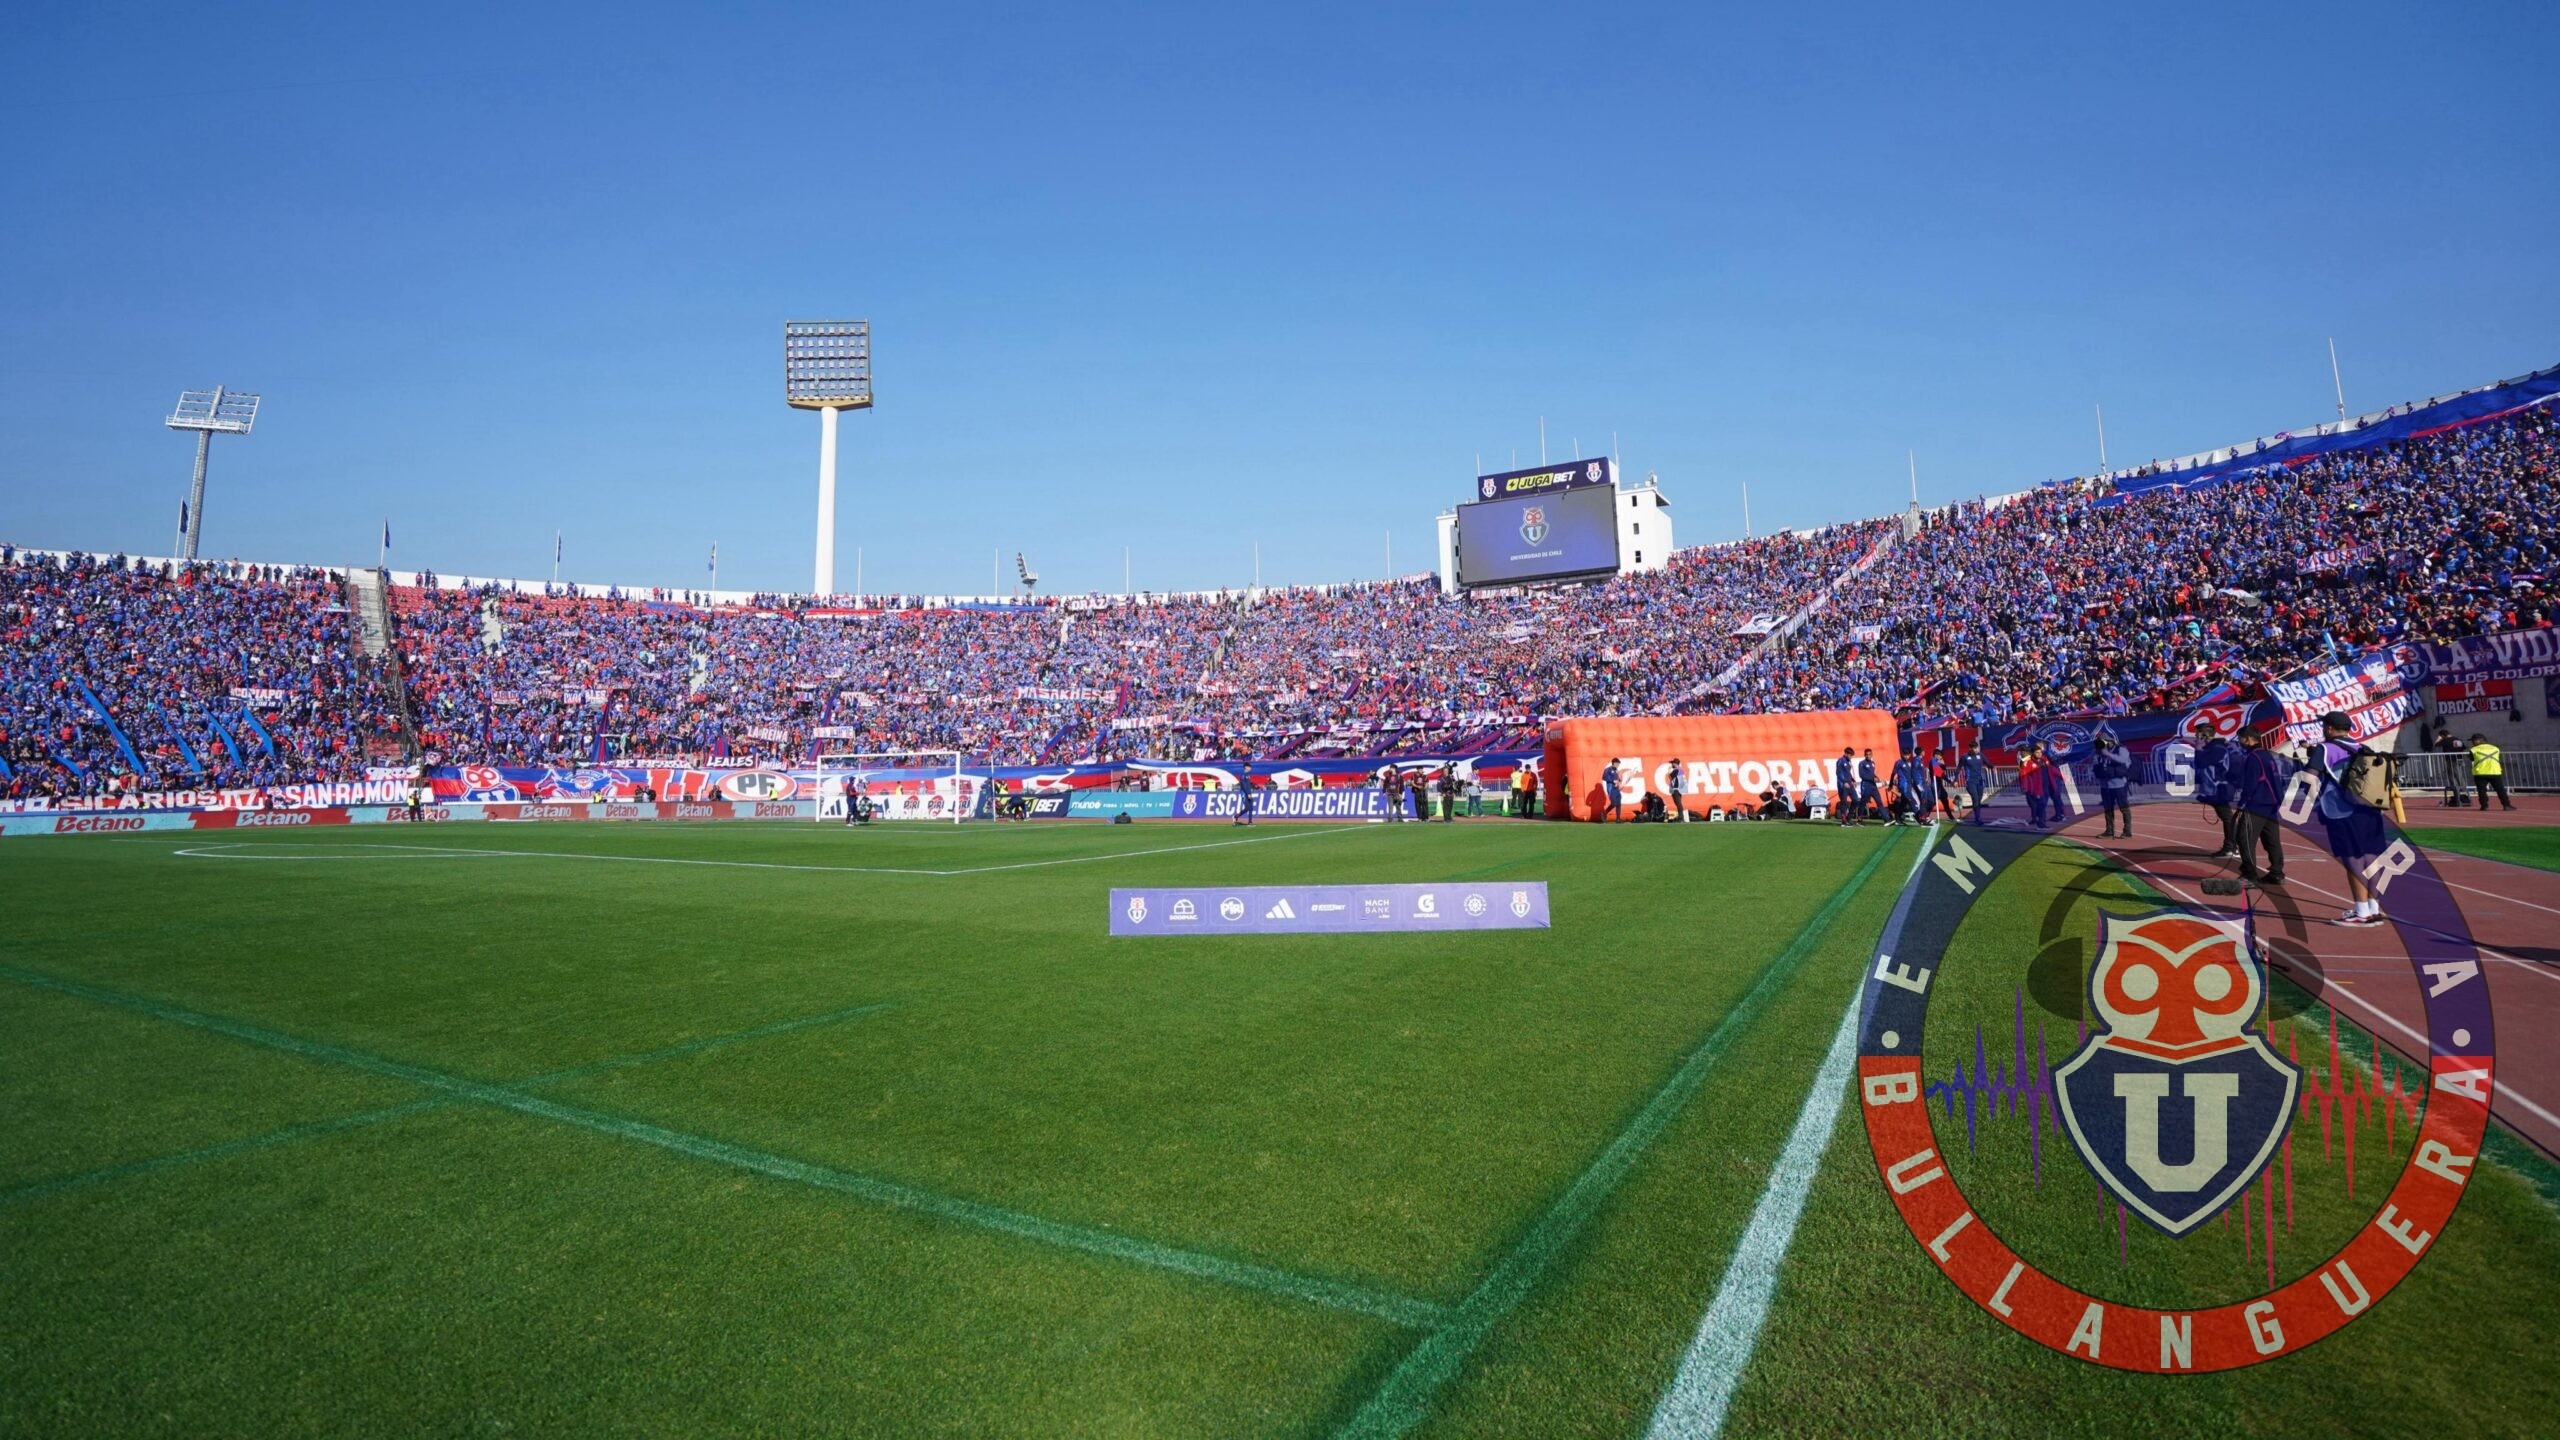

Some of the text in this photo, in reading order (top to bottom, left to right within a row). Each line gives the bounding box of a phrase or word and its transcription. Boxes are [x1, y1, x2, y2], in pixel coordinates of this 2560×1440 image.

[2420, 627, 2560, 672] LA VID
[2271, 681, 2305, 703] LOS
[2317, 665, 2358, 693] DEL
[2454, 671, 2489, 683] LOS
[2465, 681, 2486, 697] LA
[2282, 683, 2369, 724] TABLON
[706, 756, 754, 767] LEALES
[736, 773, 777, 796] PF
[519, 805, 572, 818] Betano
[605, 804, 639, 818] Betano
[676, 804, 713, 818] Betano
[754, 802, 795, 817] Betano
[54, 816, 146, 832] Betano
[235, 811, 311, 827] Betano
[1364, 906, 1390, 914] BANK
